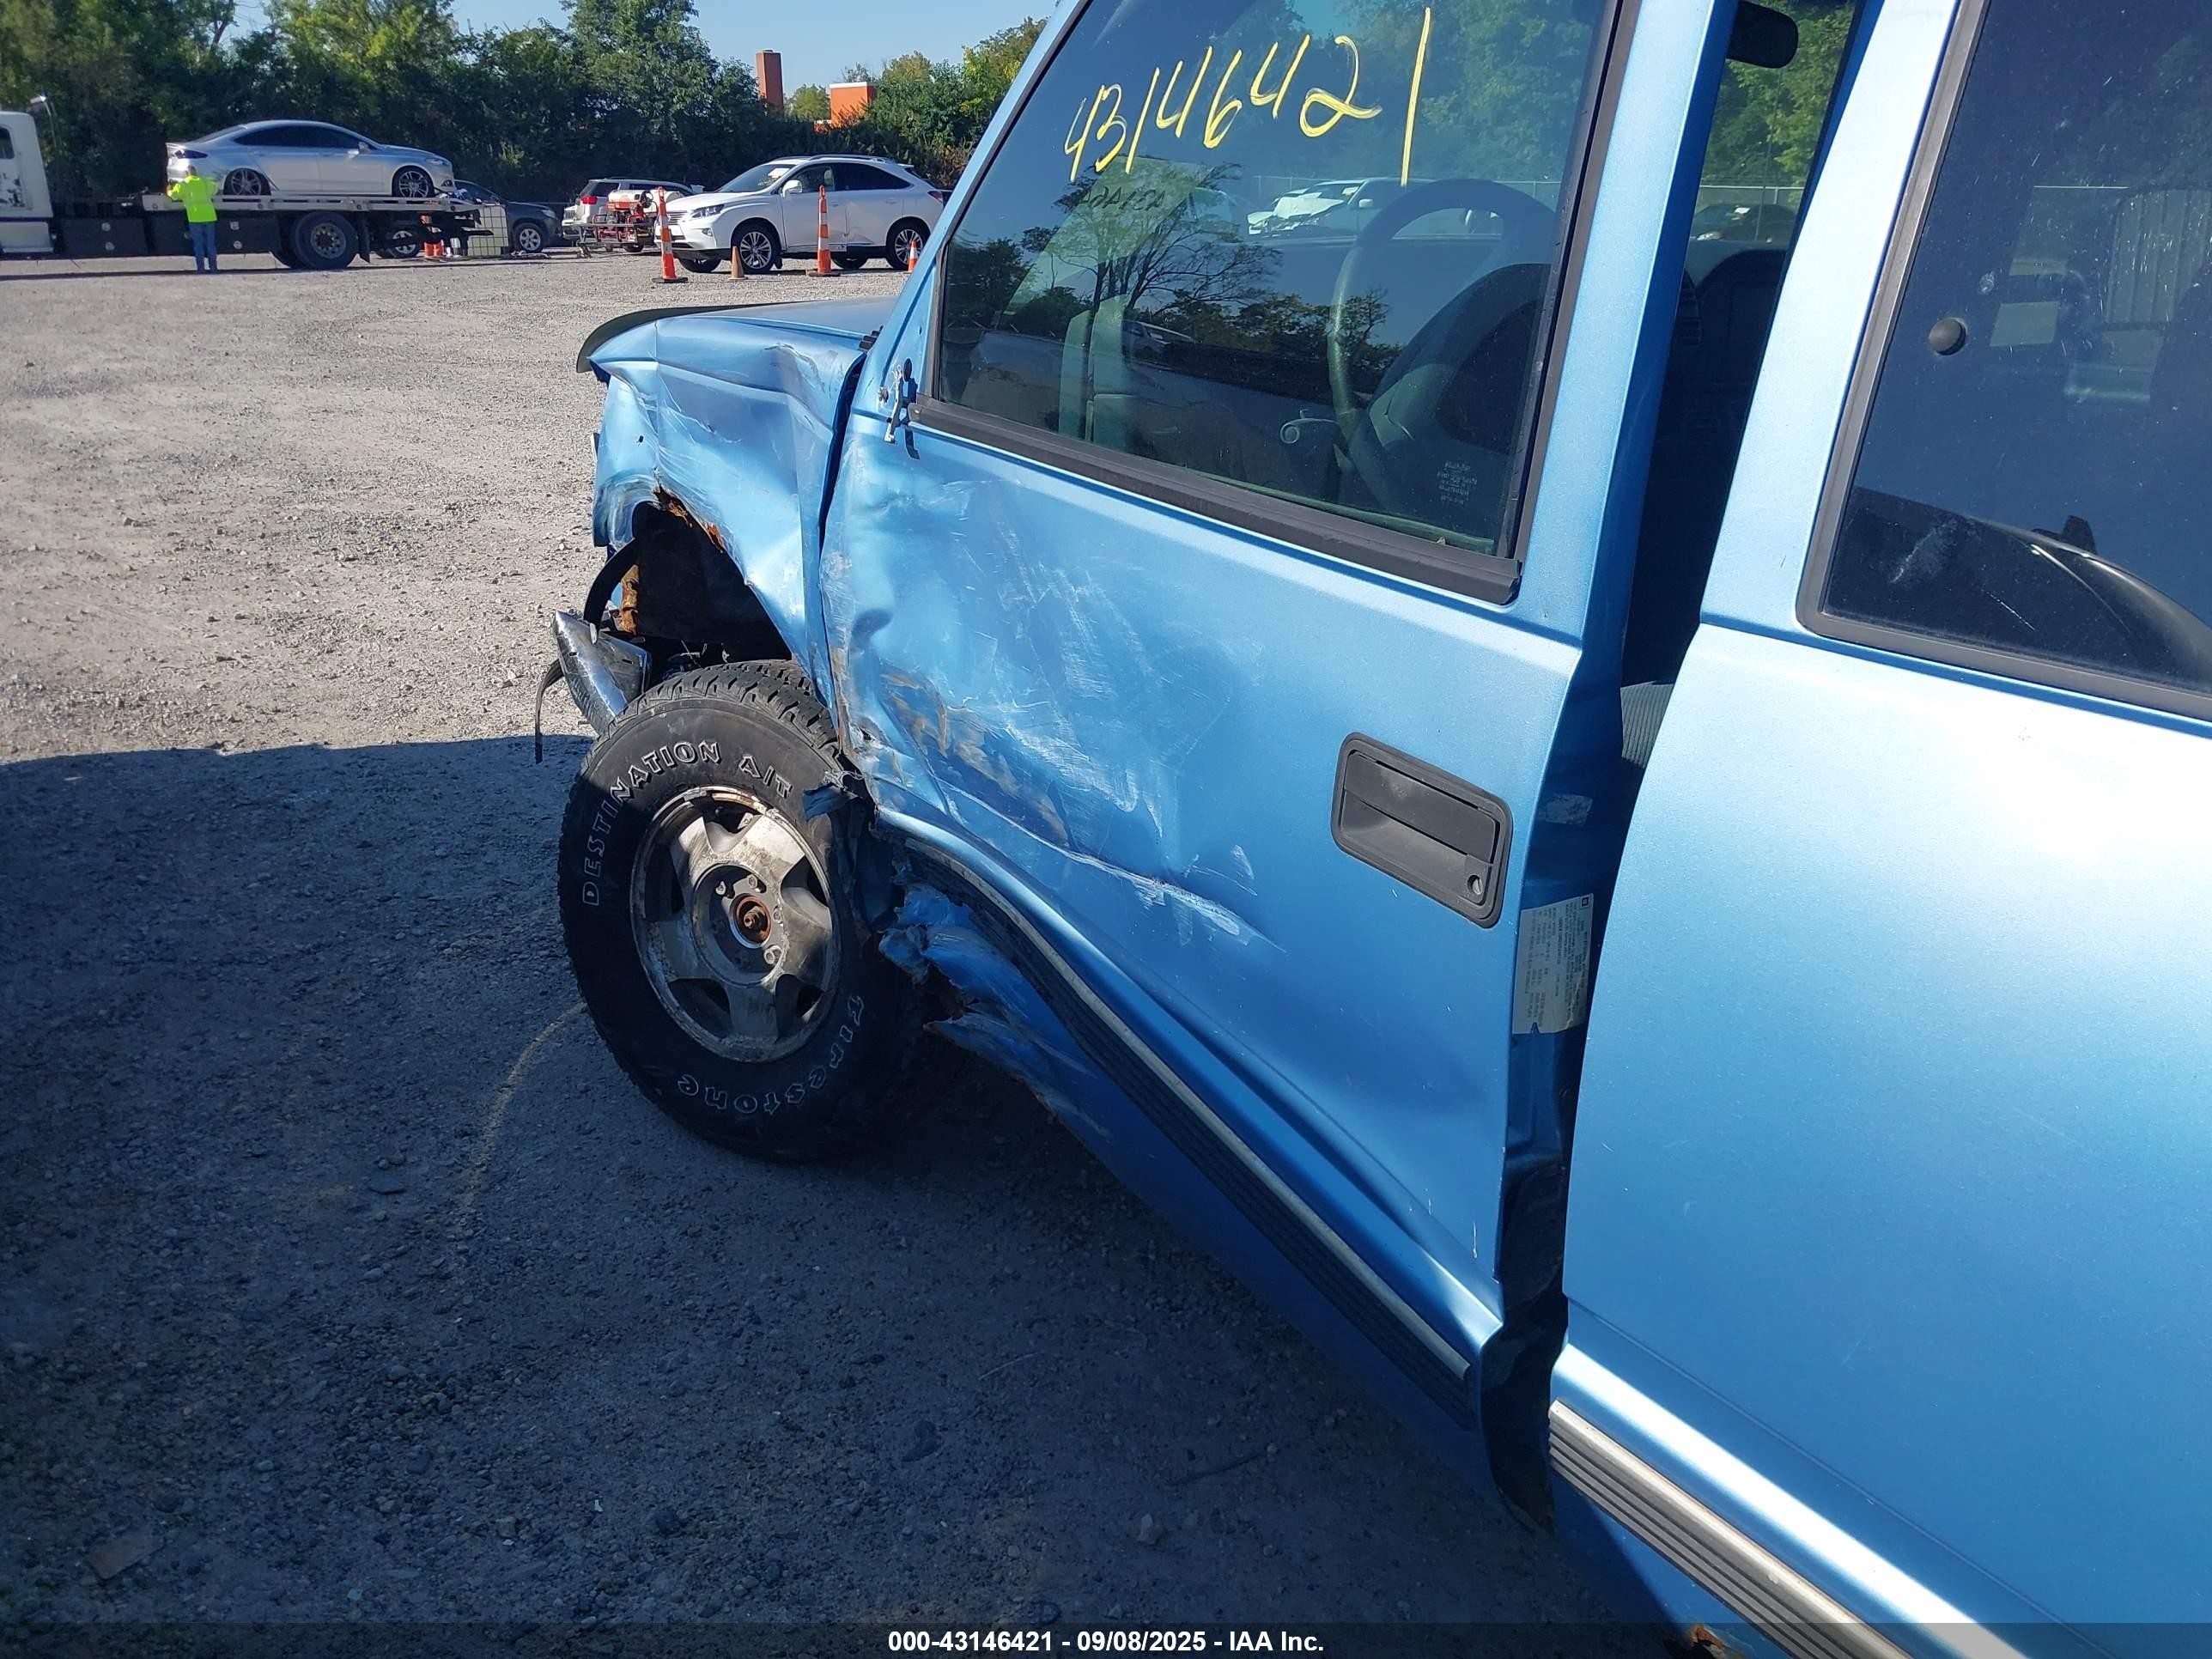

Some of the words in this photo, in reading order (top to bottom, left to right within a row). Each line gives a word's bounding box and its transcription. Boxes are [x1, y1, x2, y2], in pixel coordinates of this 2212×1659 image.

[1064, 7, 1432, 187] 43146421
[582, 740, 722, 907] DESTINATION
[678, 995, 865, 1115] Firestone
